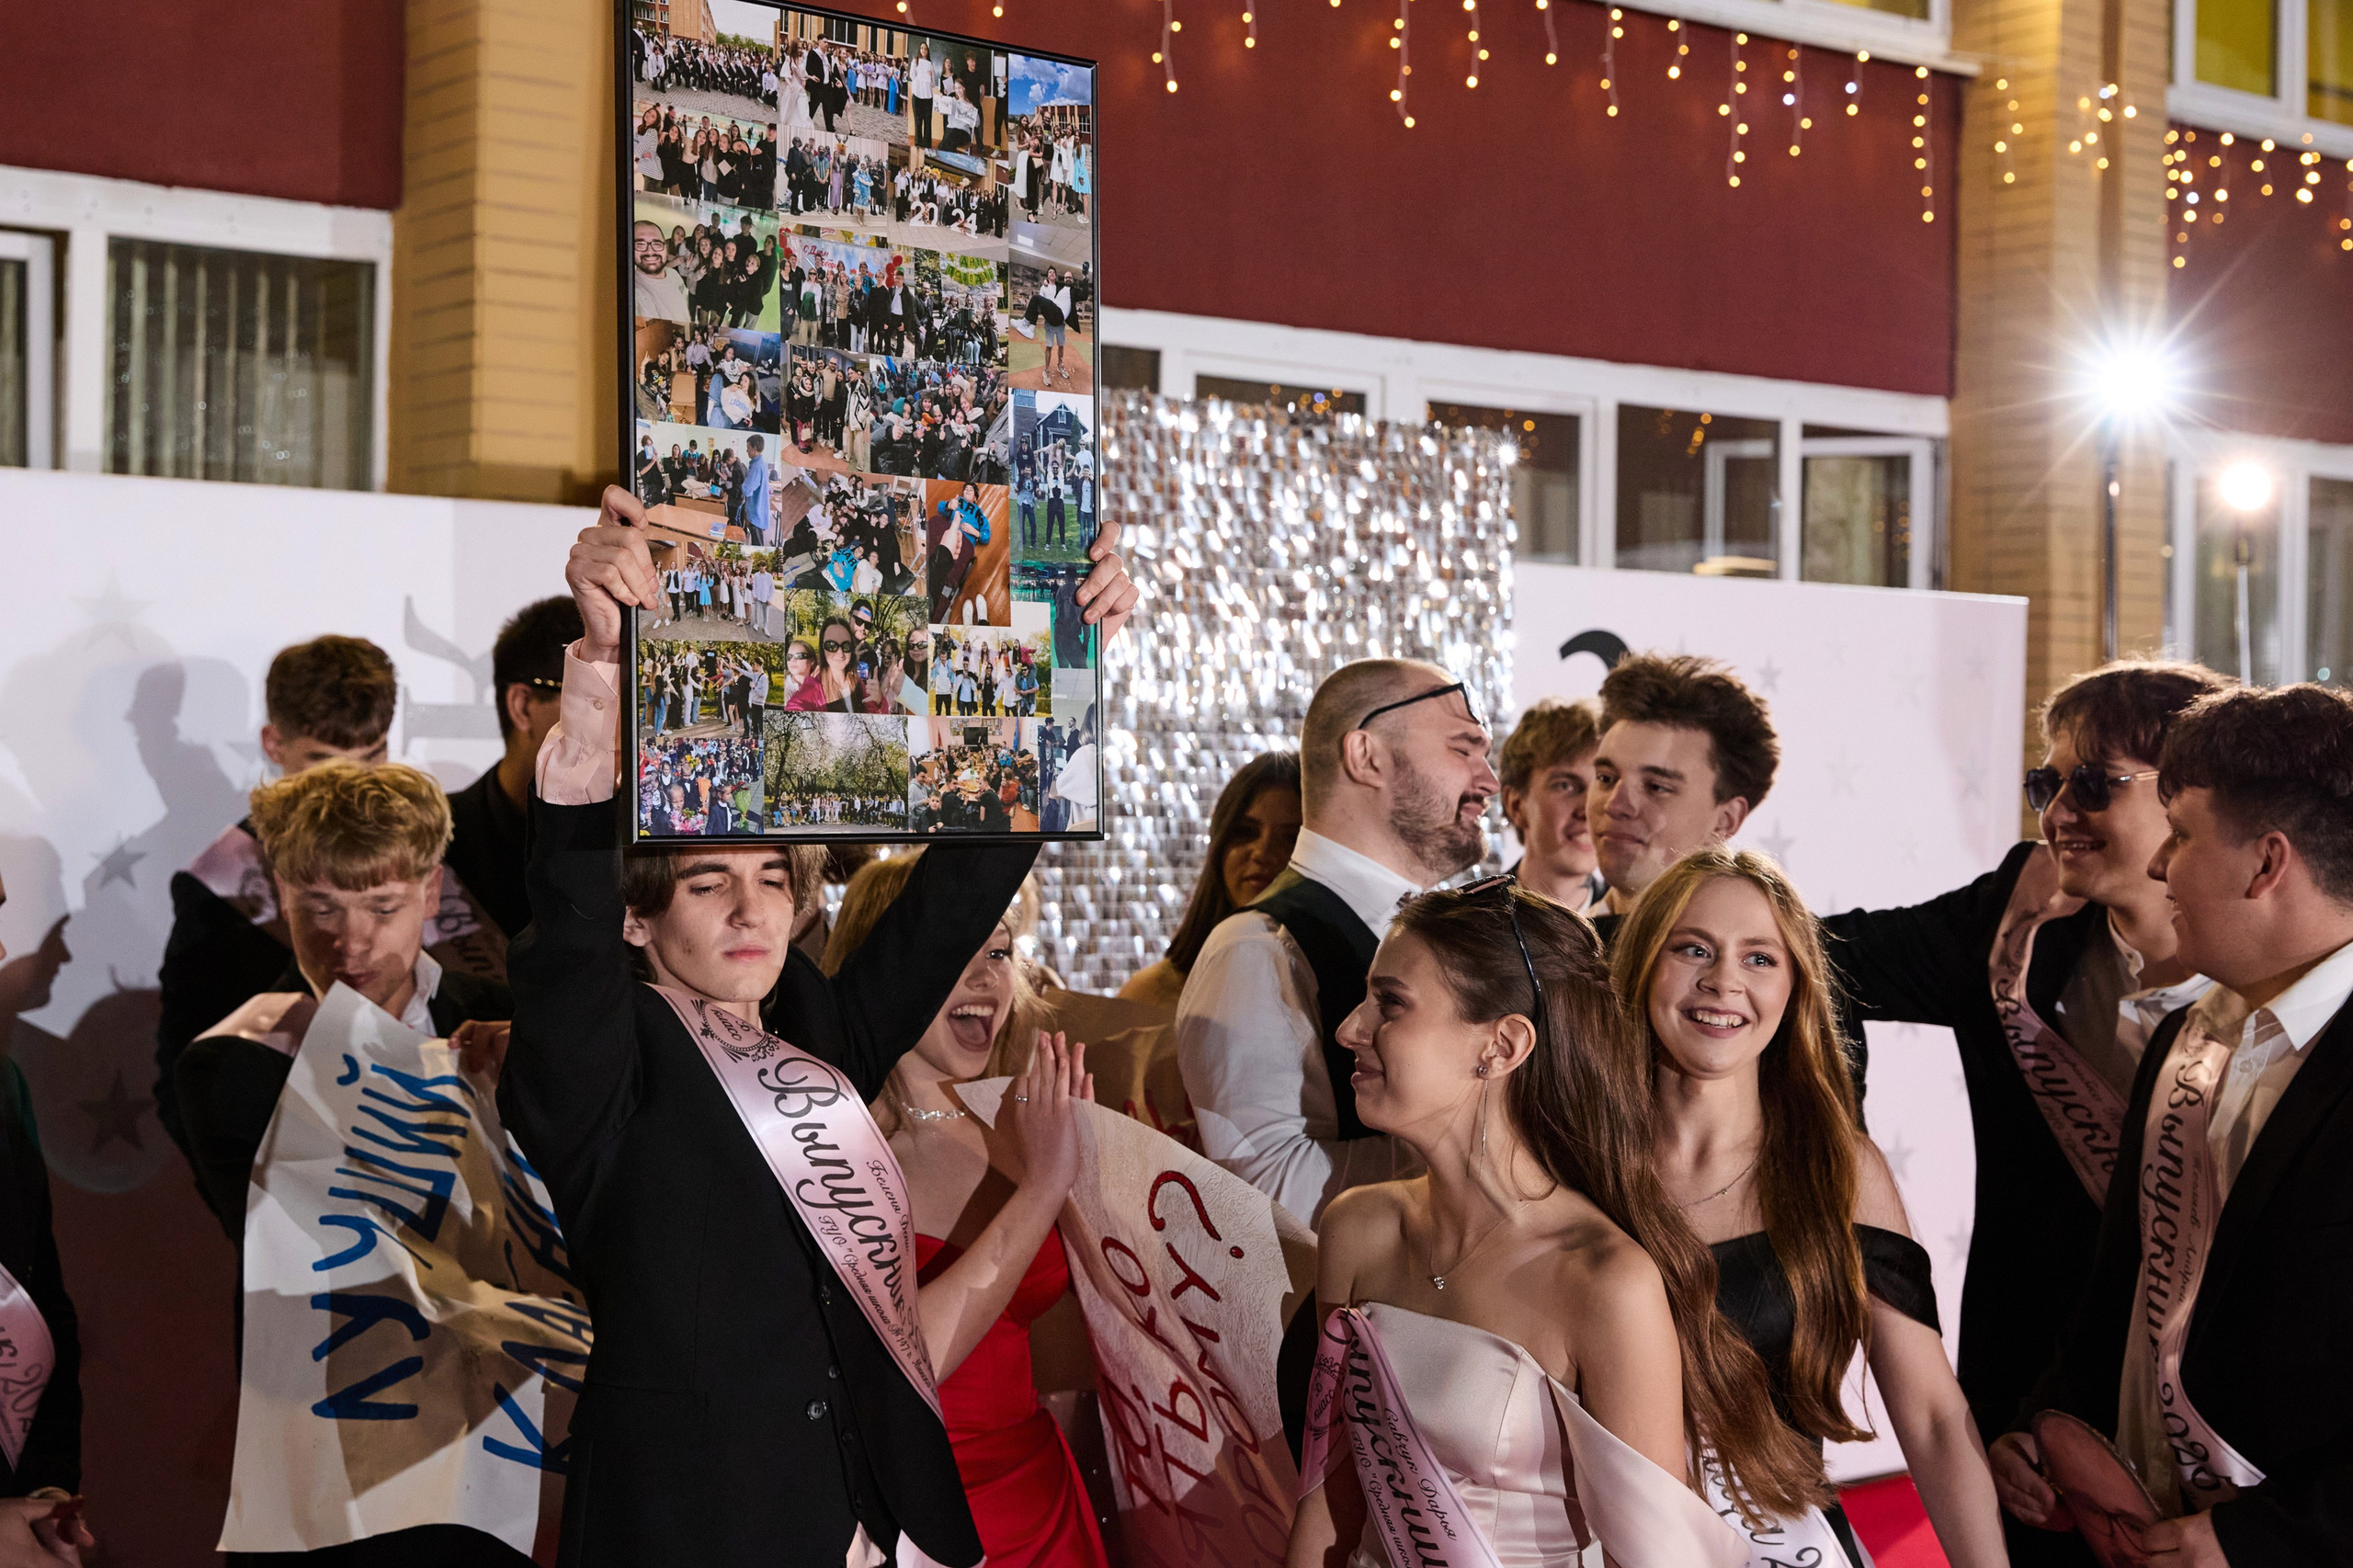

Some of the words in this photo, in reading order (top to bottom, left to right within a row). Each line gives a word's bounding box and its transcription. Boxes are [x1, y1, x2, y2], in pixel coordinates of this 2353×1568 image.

[909, 201, 938, 227] 20
[950, 209, 978, 239] 24
[1995, 979, 2119, 1173] Выпускн
[311, 1053, 477, 1421] ЛУЧШИЙ
[818, 1215, 847, 1247] ГУО
[1148, 1170, 1289, 1568] ОРОМУ?
[1153, 1377, 1225, 1568] ЯТЬ
[1417, 1478, 1458, 1541] Дарья
[1392, 1536, 1413, 1568] шко
